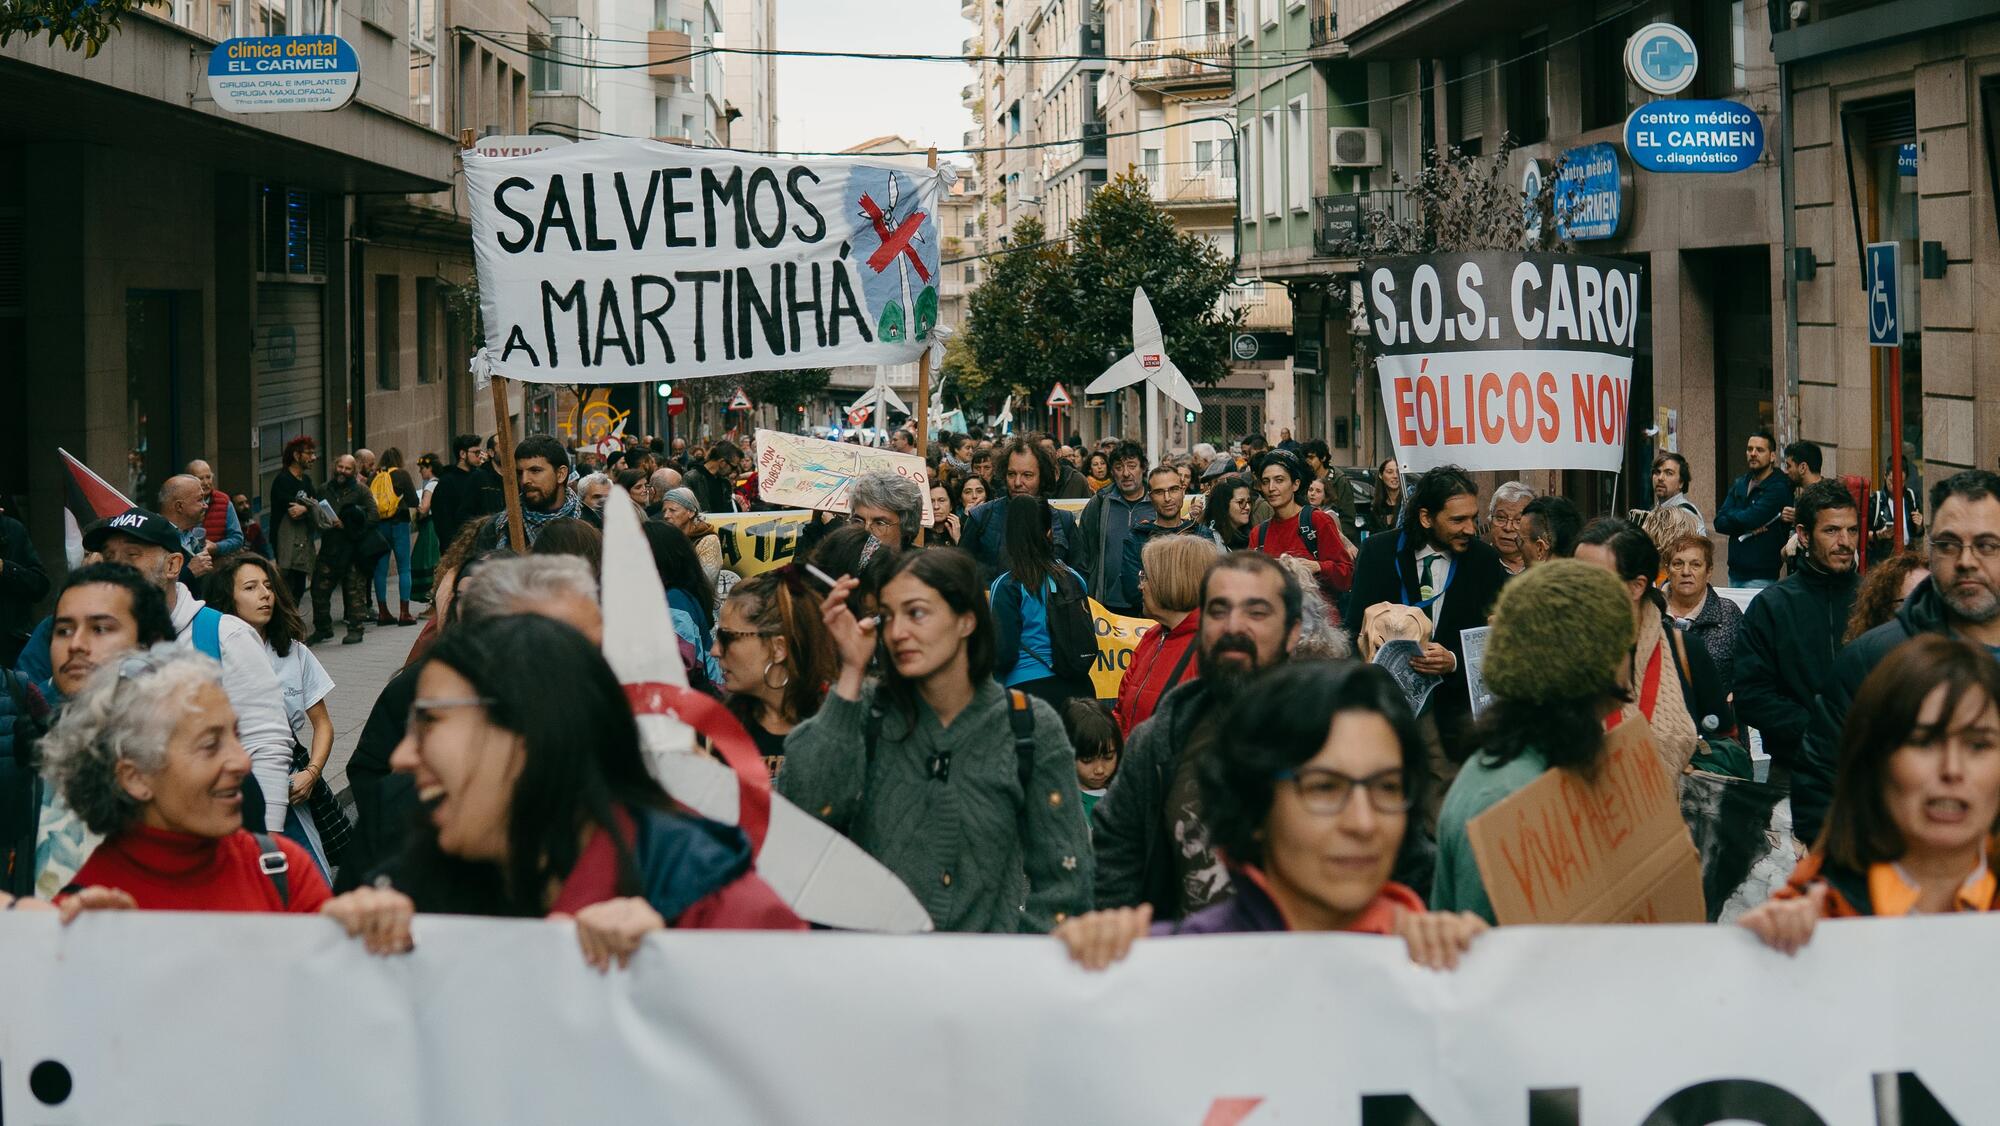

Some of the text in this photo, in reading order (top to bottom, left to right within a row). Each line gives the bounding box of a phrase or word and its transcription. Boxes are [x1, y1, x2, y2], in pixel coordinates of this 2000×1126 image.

[228, 39, 337, 58] clínica dental
[228, 58, 337, 72] EL CARMEN
[294, 78, 347, 86] IMPLANTES
[269, 88, 336, 97] MAXILOFACIAL
[1640, 111, 1750, 125] centro médico
[1636, 131, 1755, 147] EL CARMEN
[1656, 152, 1738, 165] c.diagnóstico
[493, 165, 826, 254] SALVEMOS
[1573, 191, 1617, 224] CARMEN
[501, 240, 874, 369] A MARTINHÁ
[1371, 261, 1499, 346] S.O.S.
[1394, 358, 1628, 447] EÓLICOS NON
[760, 446, 776, 468] NON
[760, 456, 786, 494] ROUBEDES
